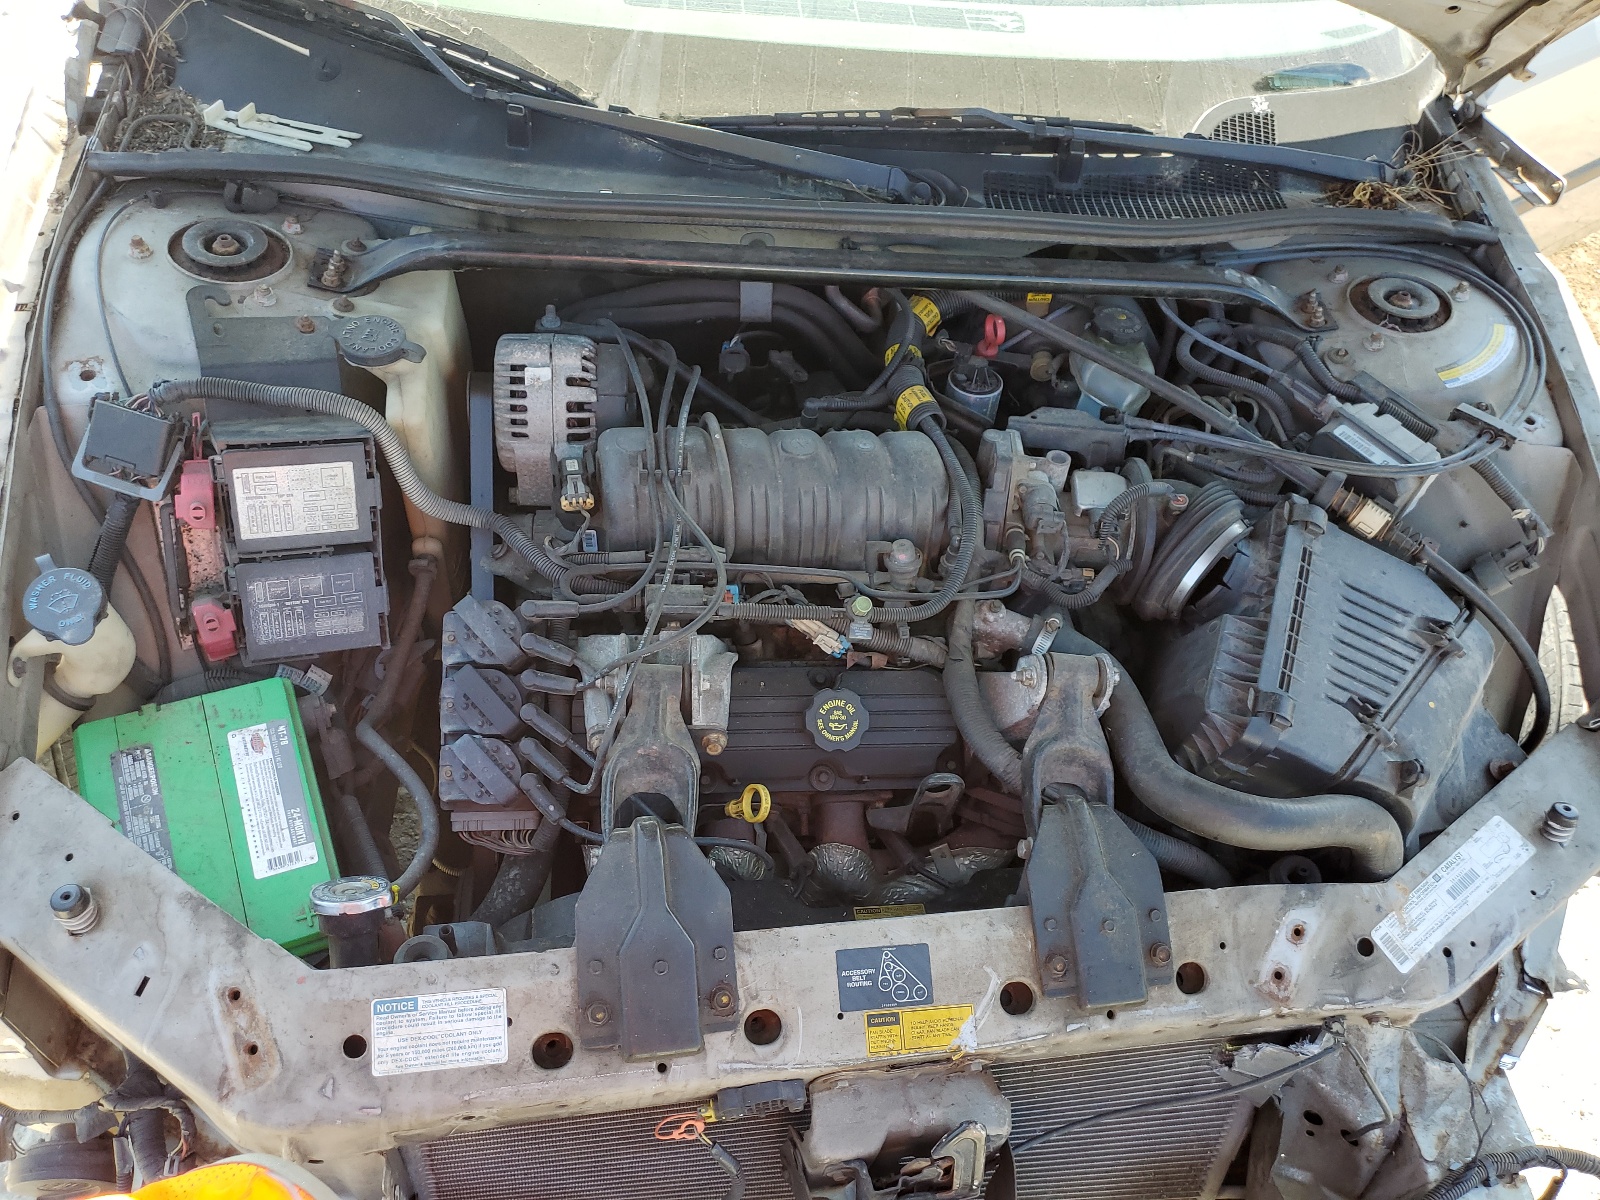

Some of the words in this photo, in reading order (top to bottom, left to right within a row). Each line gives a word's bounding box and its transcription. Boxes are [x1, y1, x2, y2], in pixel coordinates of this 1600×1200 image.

[342, 320, 360, 339] ONLY
[365, 317, 400, 334] ENGINE
[345, 338, 399, 352] COOLANT
[28, 576, 57, 610] WASHER
[64, 572, 92, 590] FLUID
[819, 700, 846, 715] ENGINE
[846, 704, 856, 716] OIL
[275, 724, 289, 746] MT-78
[822, 730, 845, 741] OWNER'S
[844, 719, 859, 739] MANUAL
[289, 806, 308, 844] 24-MONTH
[1439, 851, 1464, 873] CATALYST
[841, 967, 875, 976] ACCESSORY
[376, 1000, 414, 1013] NOTICE
[870, 1016, 895, 1024] CAUTION
